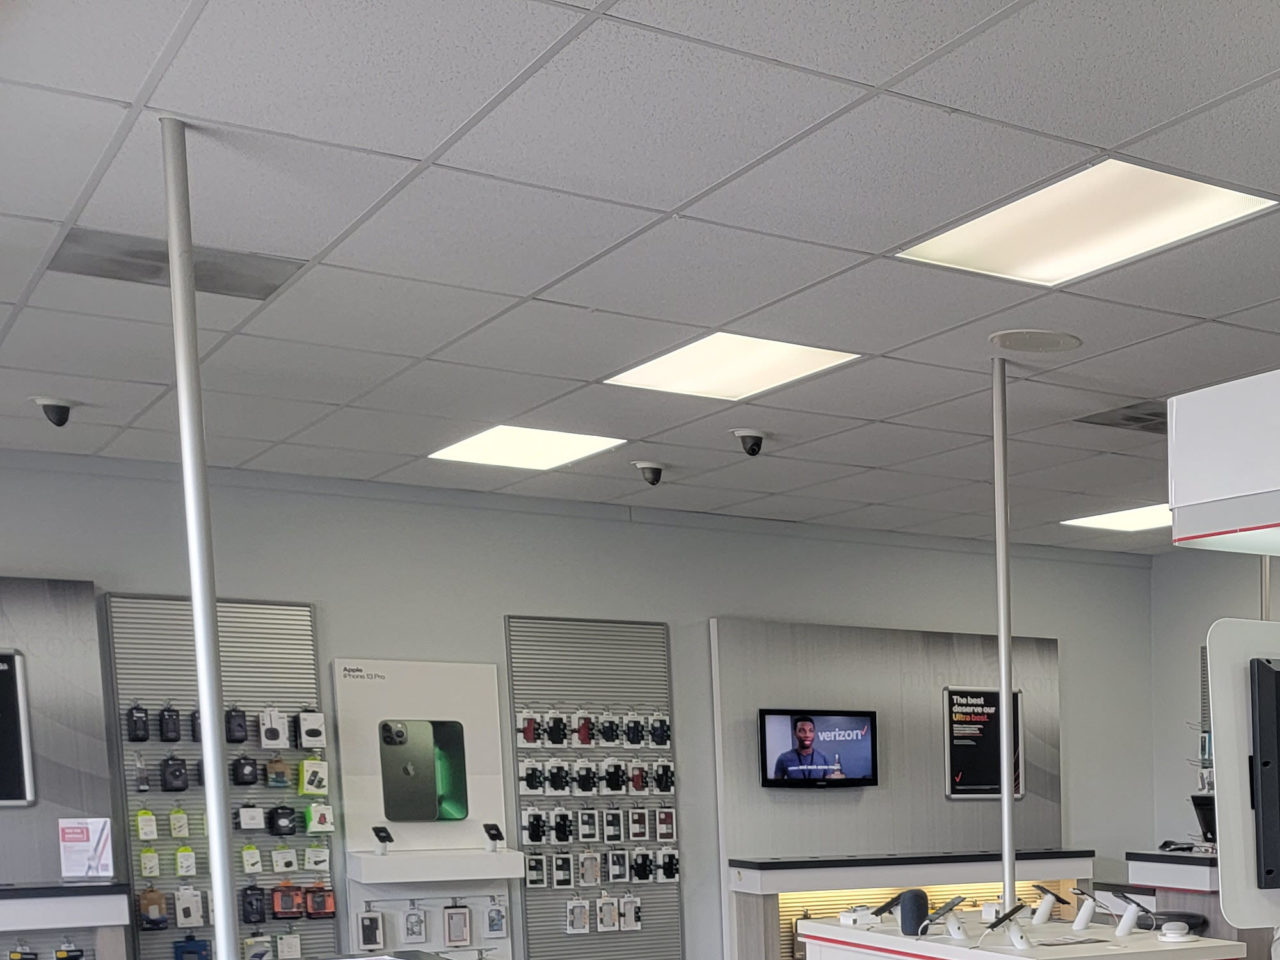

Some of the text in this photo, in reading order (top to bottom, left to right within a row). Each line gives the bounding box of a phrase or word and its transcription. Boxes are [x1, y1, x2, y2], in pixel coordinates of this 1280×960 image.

[952, 695, 984, 705] The best
[952, 705, 983, 713] deserve
[953, 713, 989, 722] Ultra best.
[818, 728, 862, 741] verizon
